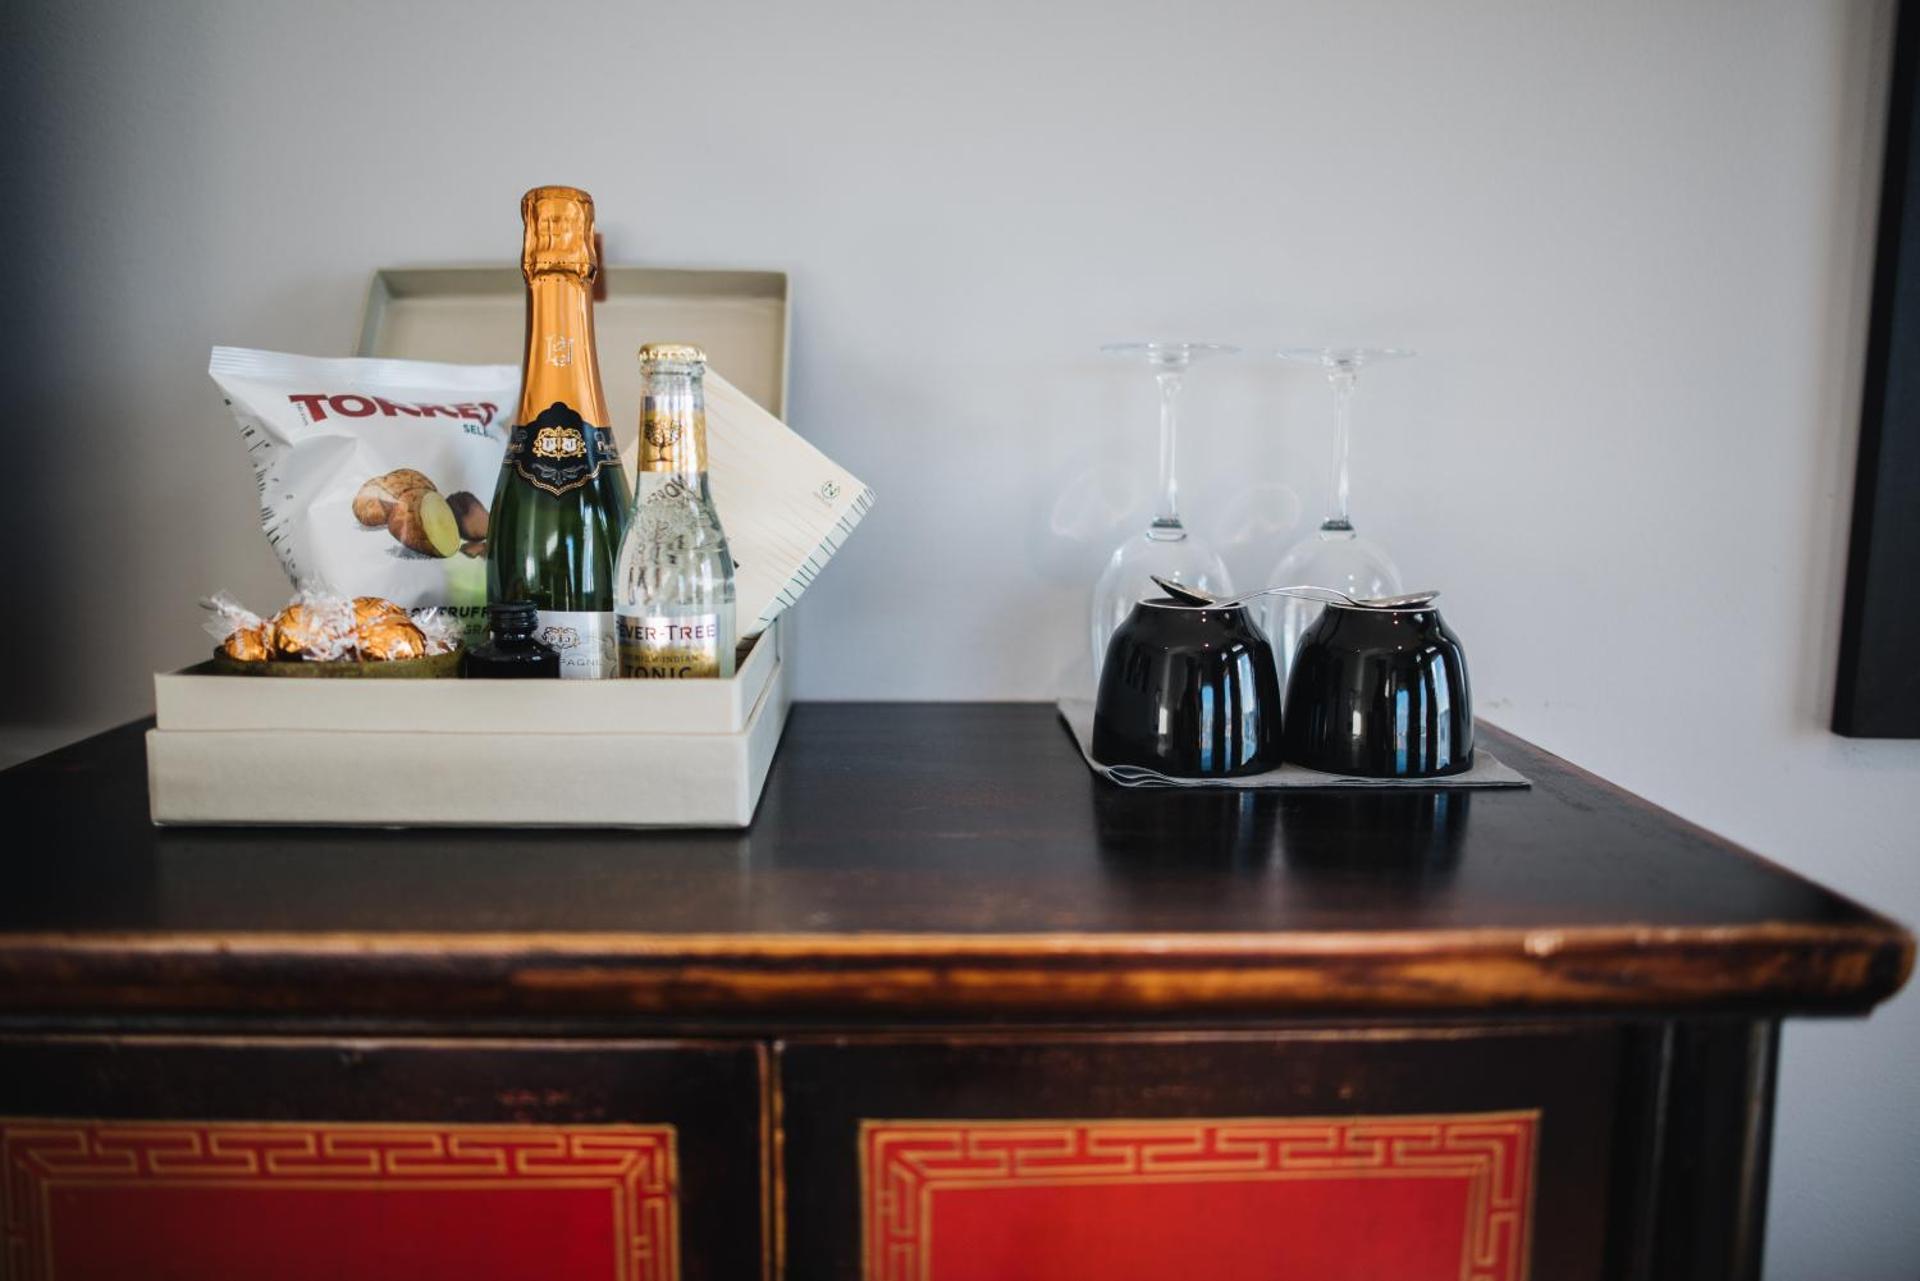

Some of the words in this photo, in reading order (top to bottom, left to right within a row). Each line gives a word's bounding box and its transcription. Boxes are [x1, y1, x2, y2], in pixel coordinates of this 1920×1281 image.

[437, 605, 489, 618] TRUFF
[616, 622, 716, 641] EVER-TREE
[625, 665, 691, 678] TONIC
